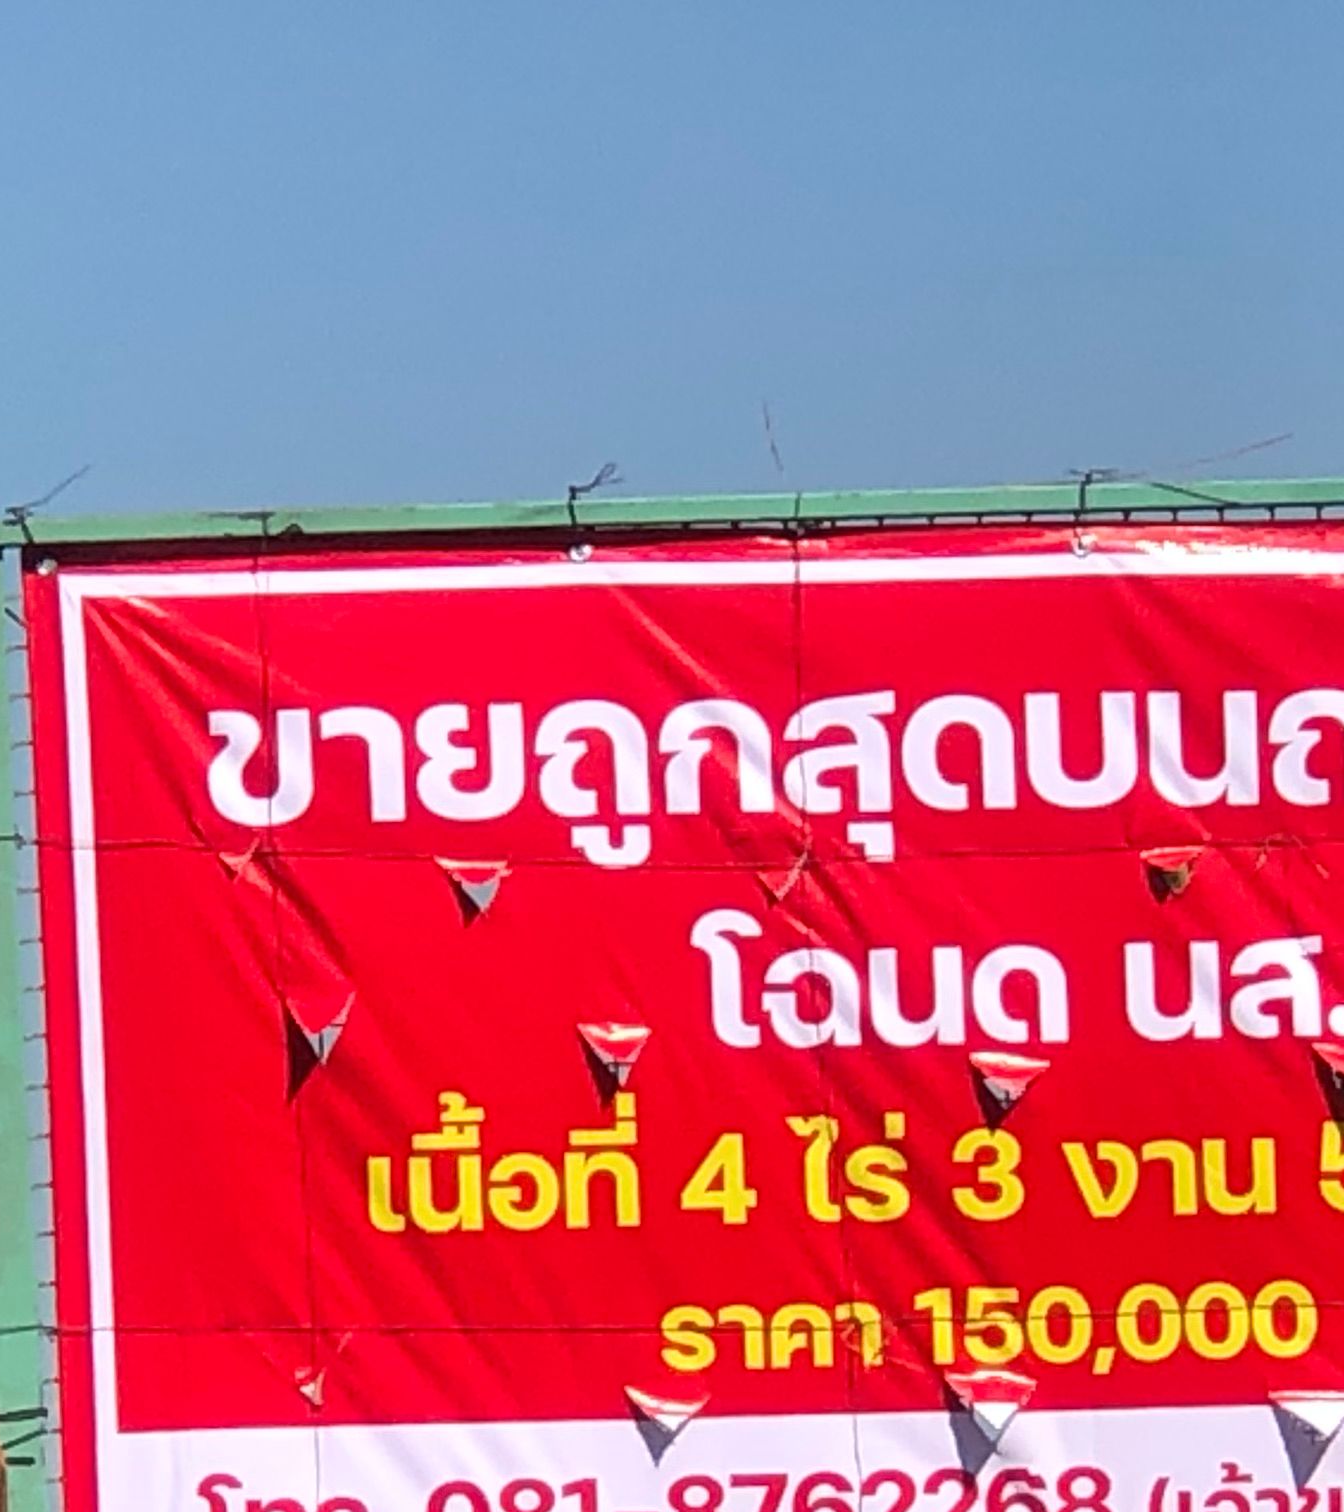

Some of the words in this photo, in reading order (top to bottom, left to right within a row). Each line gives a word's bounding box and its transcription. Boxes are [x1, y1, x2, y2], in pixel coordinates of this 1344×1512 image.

[691, 909, 1070, 1049] โฉนด
[367, 1091, 642, 1233] เนื้อที่
[680, 1132, 758, 1225] 4
[785, 1112, 911, 1223] ไร่
[952, 1127, 1026, 1222] 3
[1062, 1137, 1277, 1219] งาน
[660, 1301, 884, 1372] ราคา
[913, 1279, 1319, 1375] 150,000
